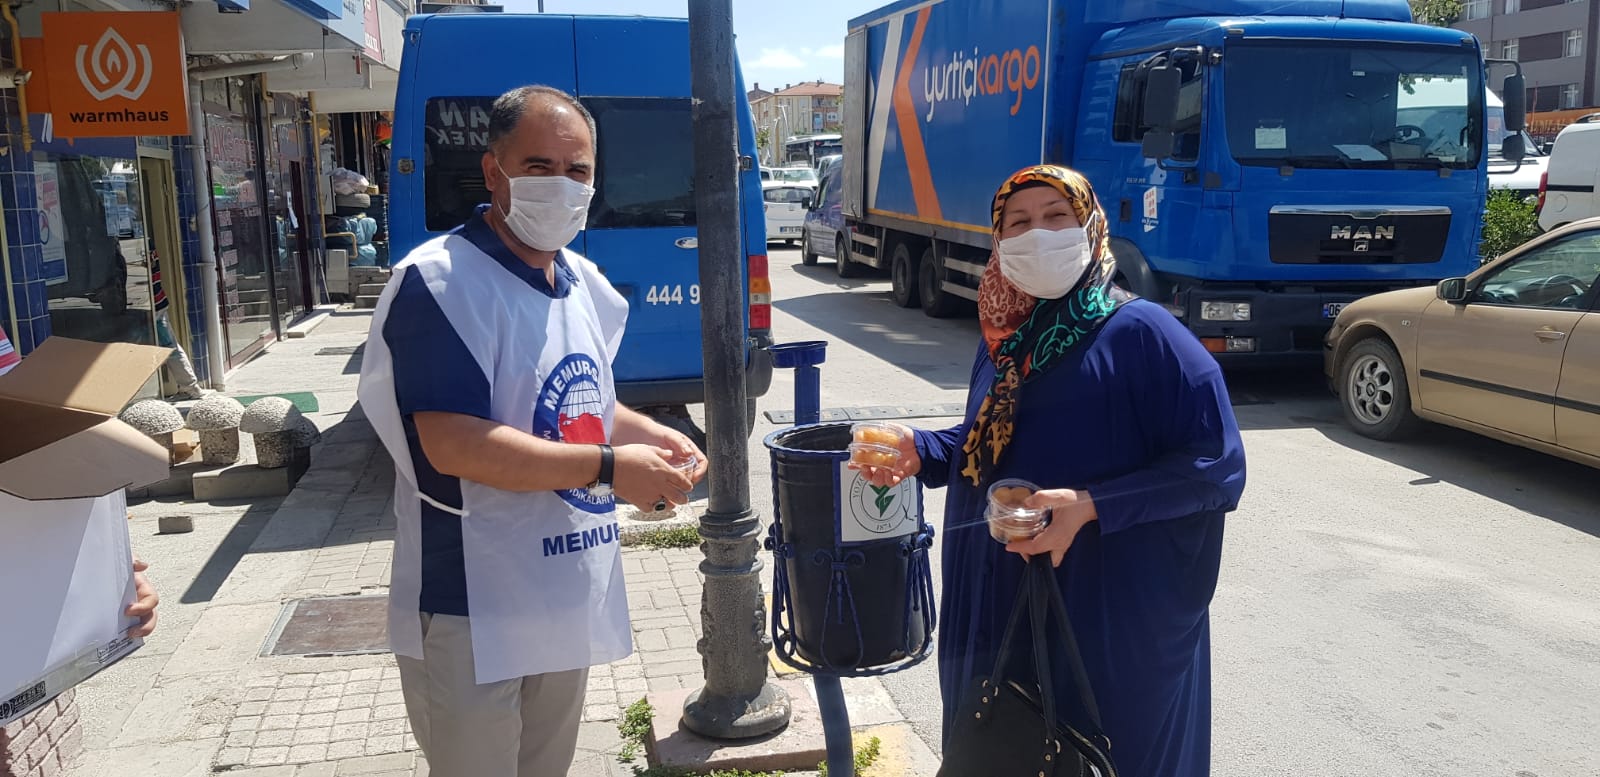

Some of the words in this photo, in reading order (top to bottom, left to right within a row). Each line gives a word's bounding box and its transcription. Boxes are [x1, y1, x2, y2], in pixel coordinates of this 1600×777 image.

[70, 108, 169, 123] warmhaus
[1331, 225, 1395, 240] MAN
[646, 285, 683, 305] 444
[689, 284, 701, 305] 9
